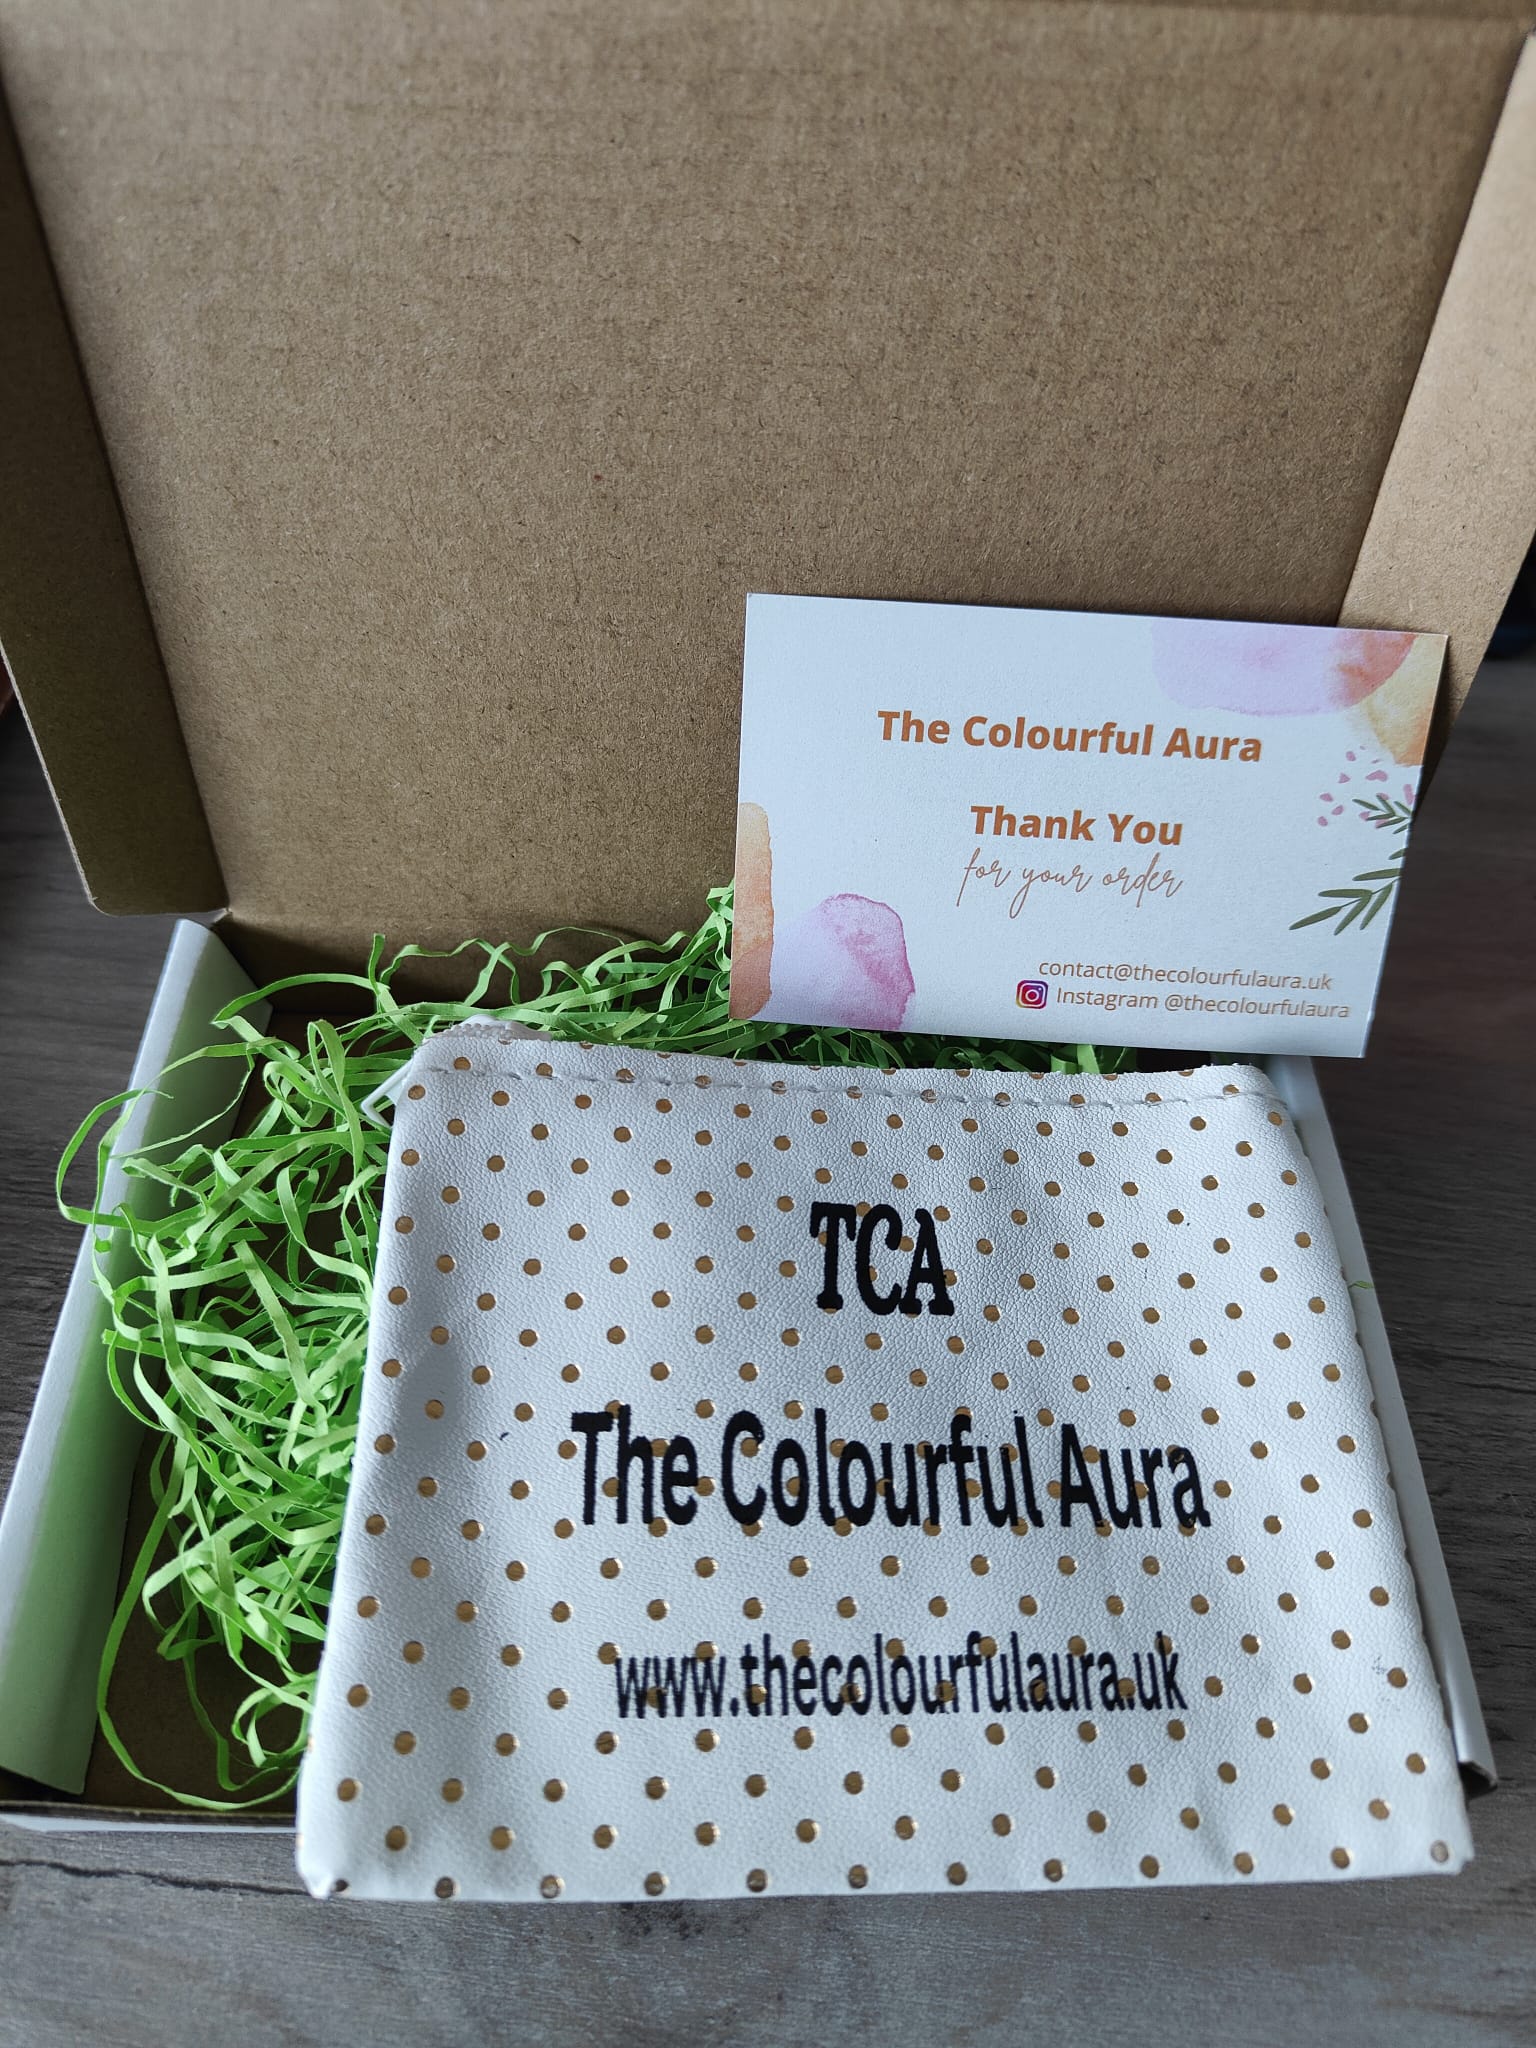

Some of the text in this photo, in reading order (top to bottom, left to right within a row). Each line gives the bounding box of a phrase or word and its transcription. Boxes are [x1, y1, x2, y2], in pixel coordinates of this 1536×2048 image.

[877, 709, 1263, 762] The Colourful Aura
[970, 805, 1184, 846] Thank You
[956, 847, 1184, 919] for your order
[1038, 957, 1332, 992] contact@thecolourfulaura.uk
[1056, 986, 1350, 1019] Instagram @thecolourfulaura
[810, 1201, 954, 1316] TCA
[571, 1405, 1211, 1528] The Colourful Aura
[614, 1630, 1188, 1718] www.thecolourfulaura.uk
